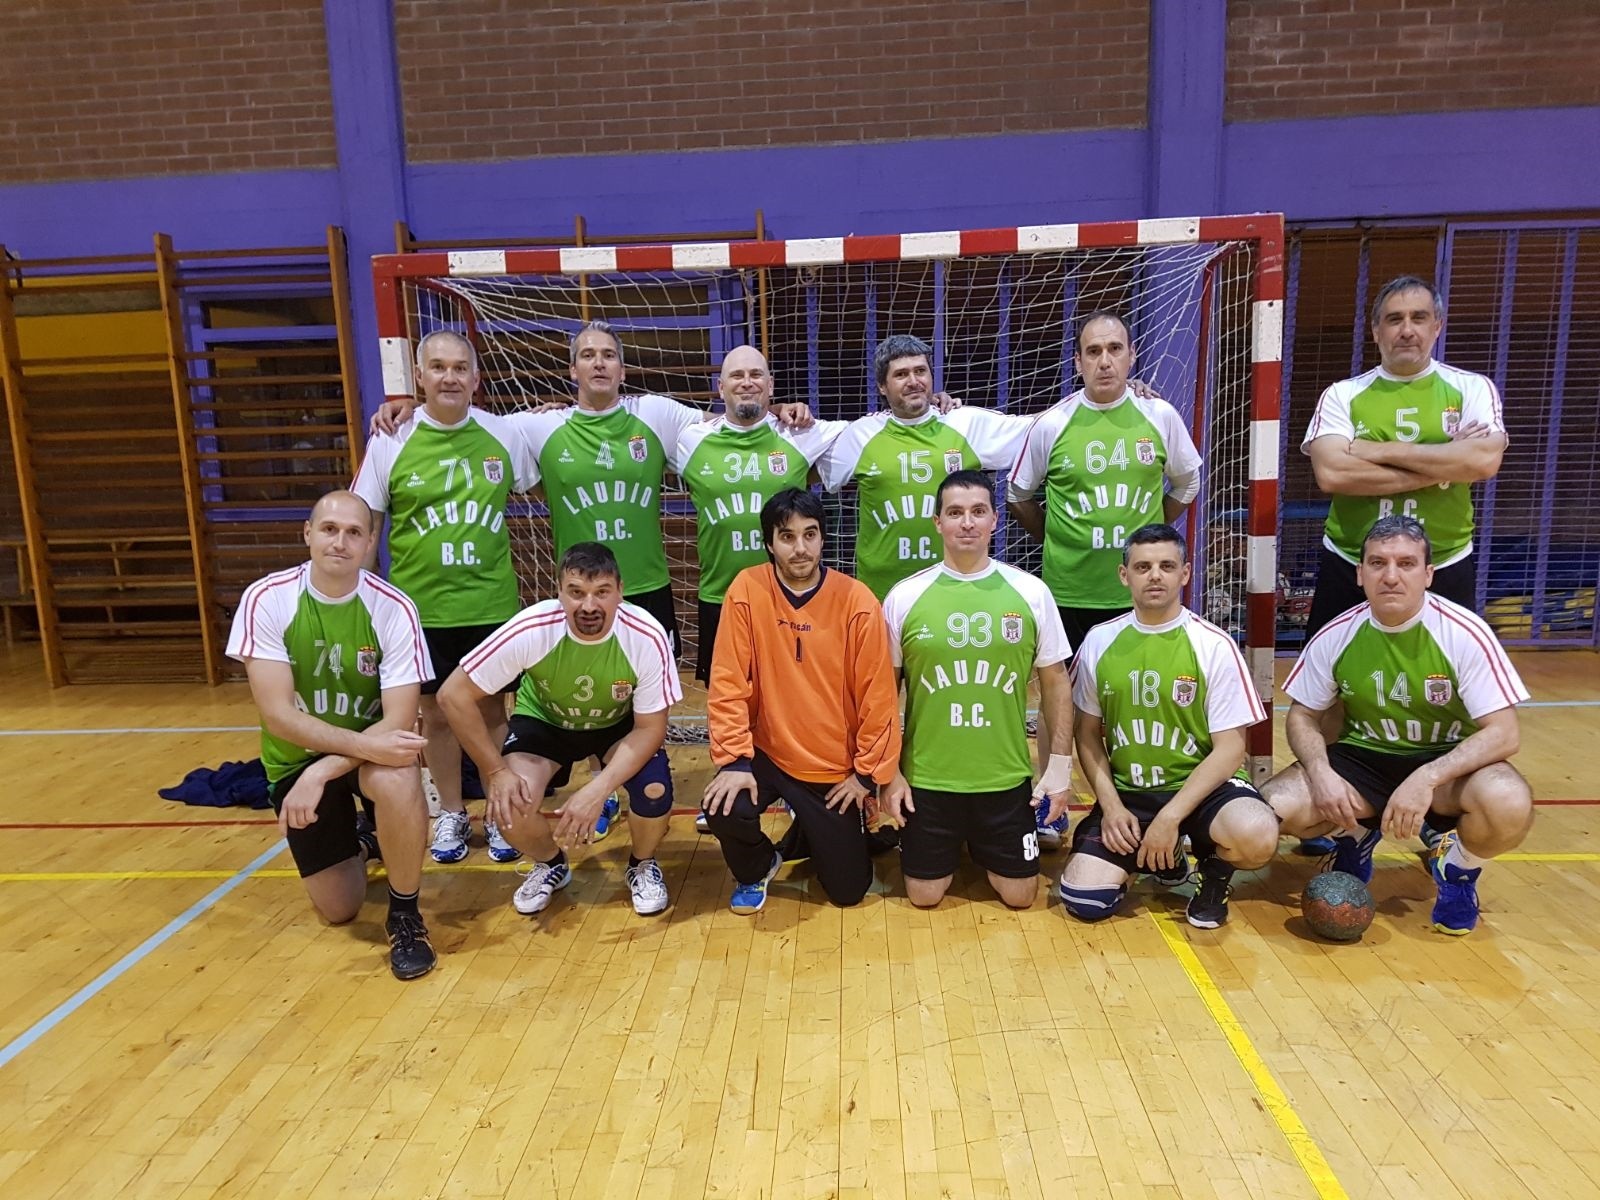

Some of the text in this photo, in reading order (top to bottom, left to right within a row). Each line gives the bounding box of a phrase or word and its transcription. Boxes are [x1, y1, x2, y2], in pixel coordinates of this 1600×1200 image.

[1395, 407, 1420, 442] 5
[595, 440, 615, 470] 4
[723, 452, 762, 483] 34
[896, 450, 934, 483] 15
[1085, 438, 1130, 474] 64
[439, 458, 474, 492] 71
[562, 480, 653, 515] LAUDIO
[704, 492, 764, 526] LAUD
[871, 494, 936, 530] LAUD
[1065, 483, 1153, 520] LAUDIO
[1378, 499, 1425, 524] BC.
[410, 501, 503, 536] LAUDIO
[595, 518, 633, 541] B.C.
[441, 541, 481, 566] B.C.
[898, 537, 938, 560] B.C.
[1092, 525, 1126, 549] B.C
[946, 612, 993, 648] 93
[313, 639, 344, 680] 74
[920, 659, 1018, 694] LAUDIO
[294, 688, 382, 720] AUDIO
[572, 674, 594, 702] 3
[1127, 669, 1161, 708] 18
[1369, 670, 1412, 708] 14
[950, 703, 991, 727] B.C.
[1112, 719, 1198, 756] AUDIO
